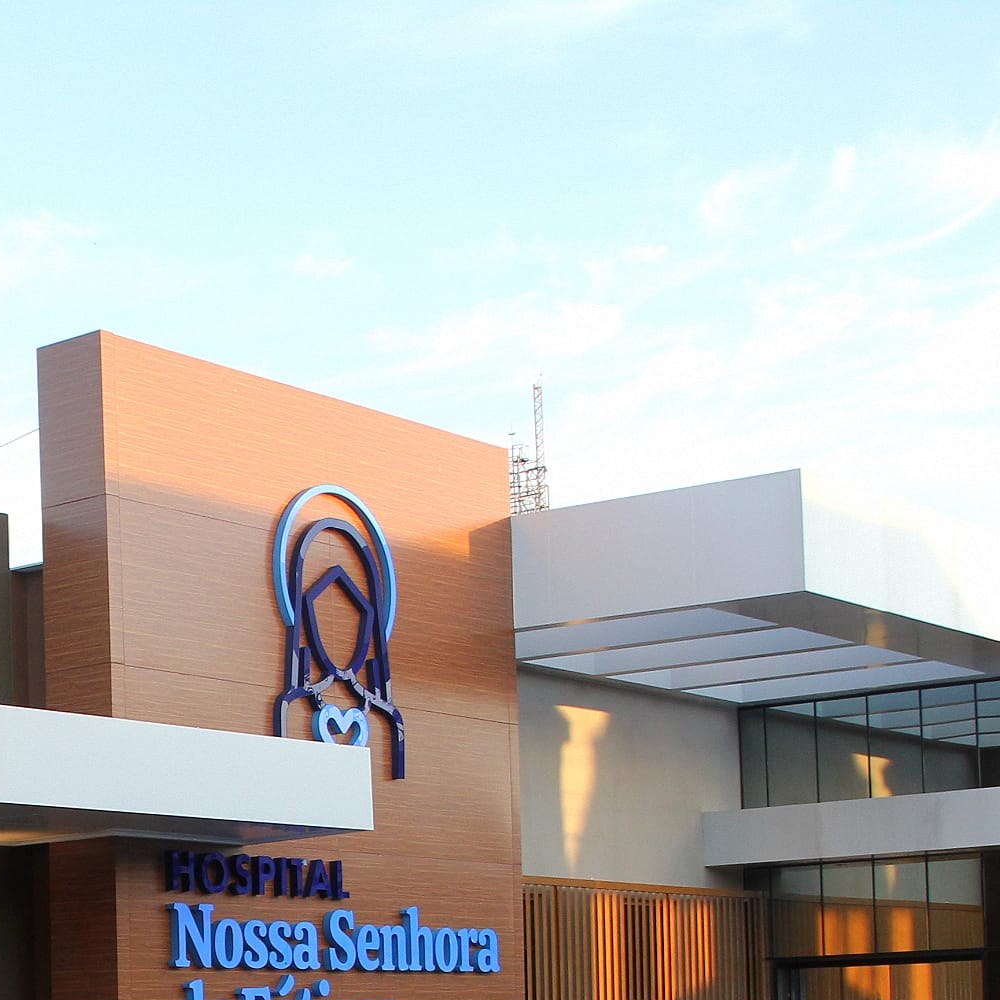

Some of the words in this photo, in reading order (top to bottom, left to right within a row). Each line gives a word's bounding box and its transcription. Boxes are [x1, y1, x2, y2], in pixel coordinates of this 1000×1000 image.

[166, 850, 350, 899] HOSPITAL
[167, 902, 320, 970] Nossa
[323, 906, 501, 973] Senhora
